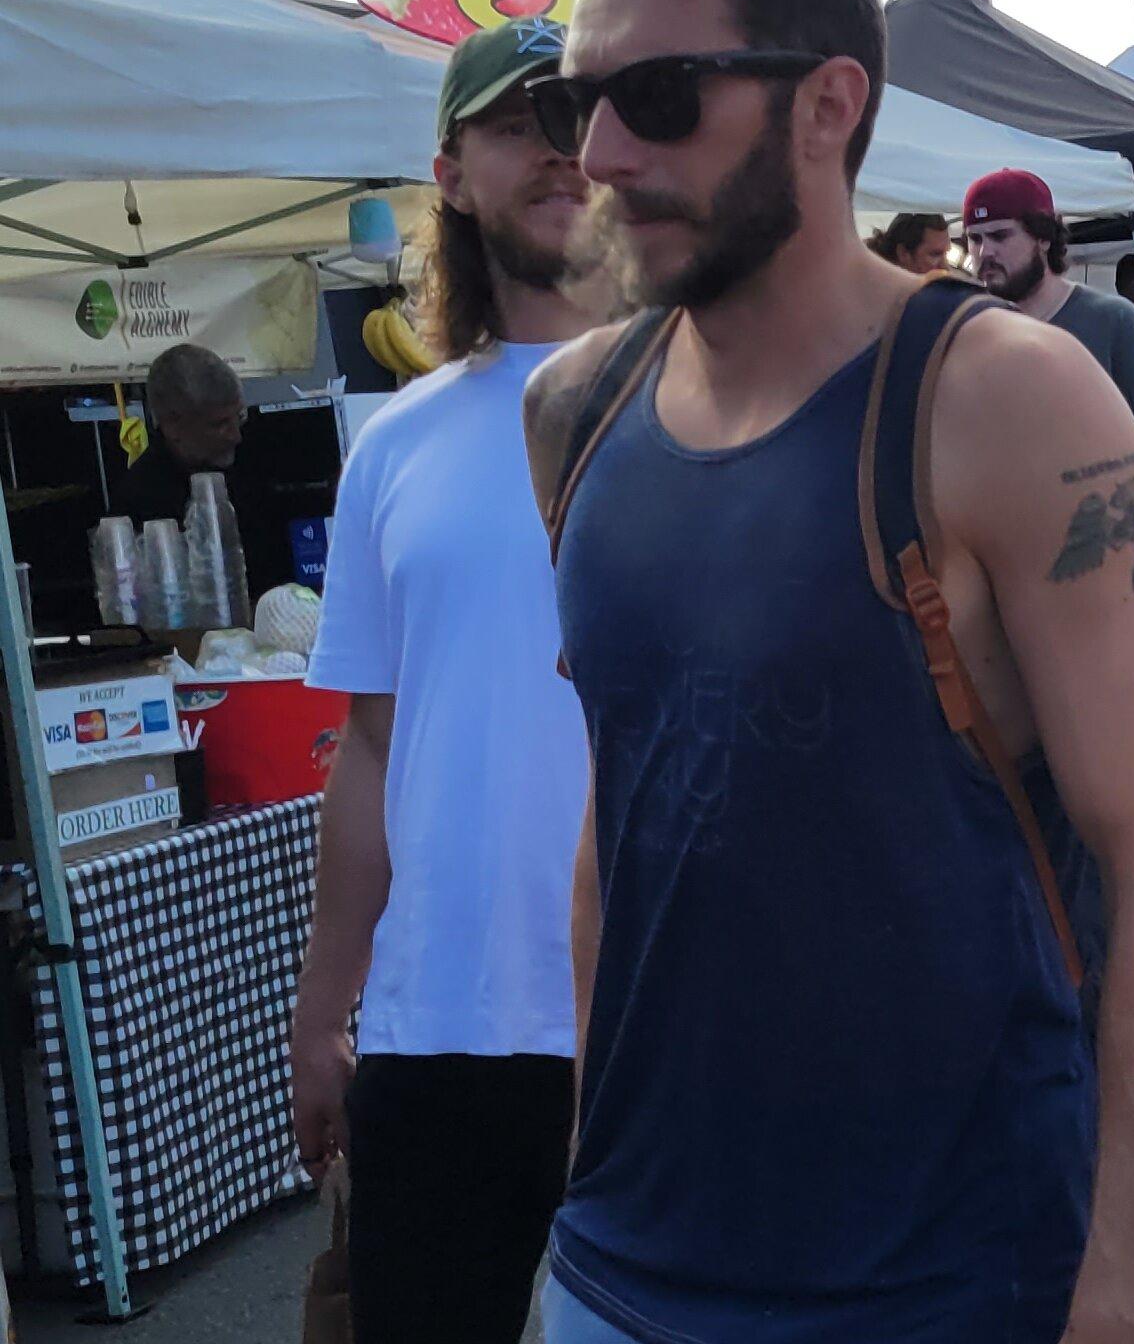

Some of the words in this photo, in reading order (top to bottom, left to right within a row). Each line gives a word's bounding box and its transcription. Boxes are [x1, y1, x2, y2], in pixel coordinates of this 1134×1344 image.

[129, 281, 171, 309] EDIBLE
[302, 563, 326, 575] VISA
[79, 690, 92, 704] WE
[93, 686, 125, 702] ACCEPT
[43, 723, 72, 744] VISA
[60, 805, 127, 840] ORDER
[127, 792, 179, 825] HERE
